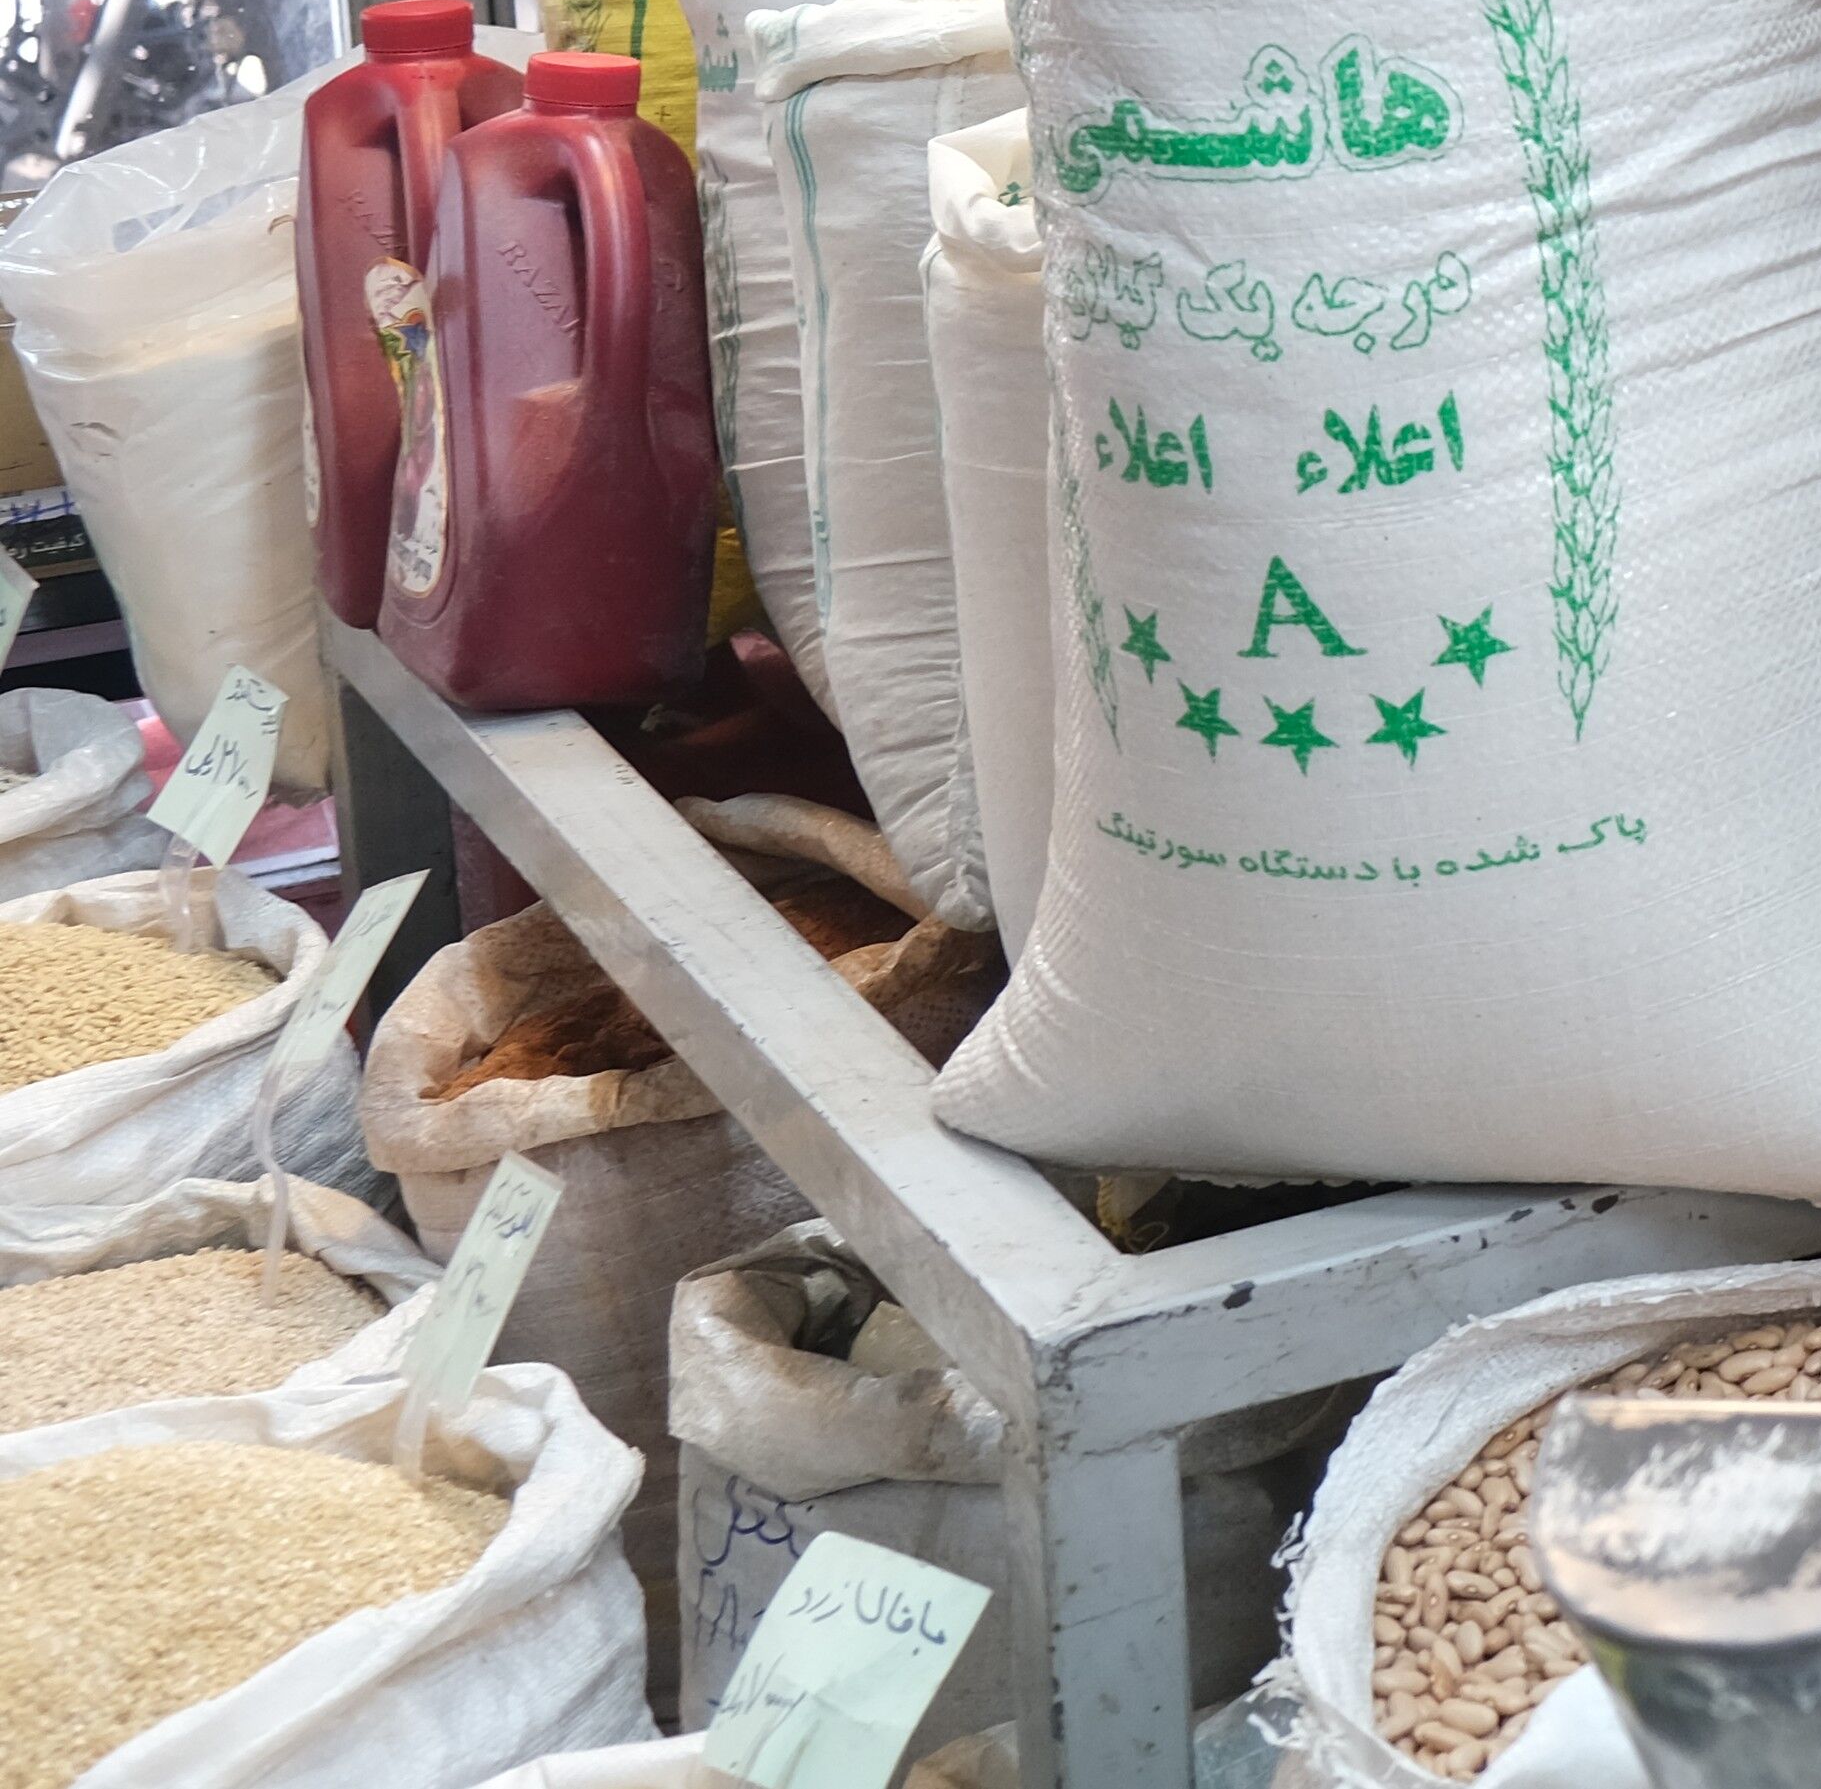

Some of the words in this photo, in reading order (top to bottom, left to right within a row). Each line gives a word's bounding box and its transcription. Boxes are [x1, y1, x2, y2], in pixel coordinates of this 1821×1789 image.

[1052, 35, 1463, 204] هاشمی
[1175, 257, 1277, 363] یک
[1290, 249, 1473, 356] درجه
[1094, 388, 1215, 496] اعلاء
[1294, 389, 1467, 496] اعلاء
[1236, 554, 1368, 659] A
[1094, 809, 1228, 871] سورتینگ
[1237, 850, 1381, 883] دستگاه
[1389, 853, 1422, 884] با
[1433, 834, 1545, 879] شده
[1554, 811, 1651, 857] پاک
